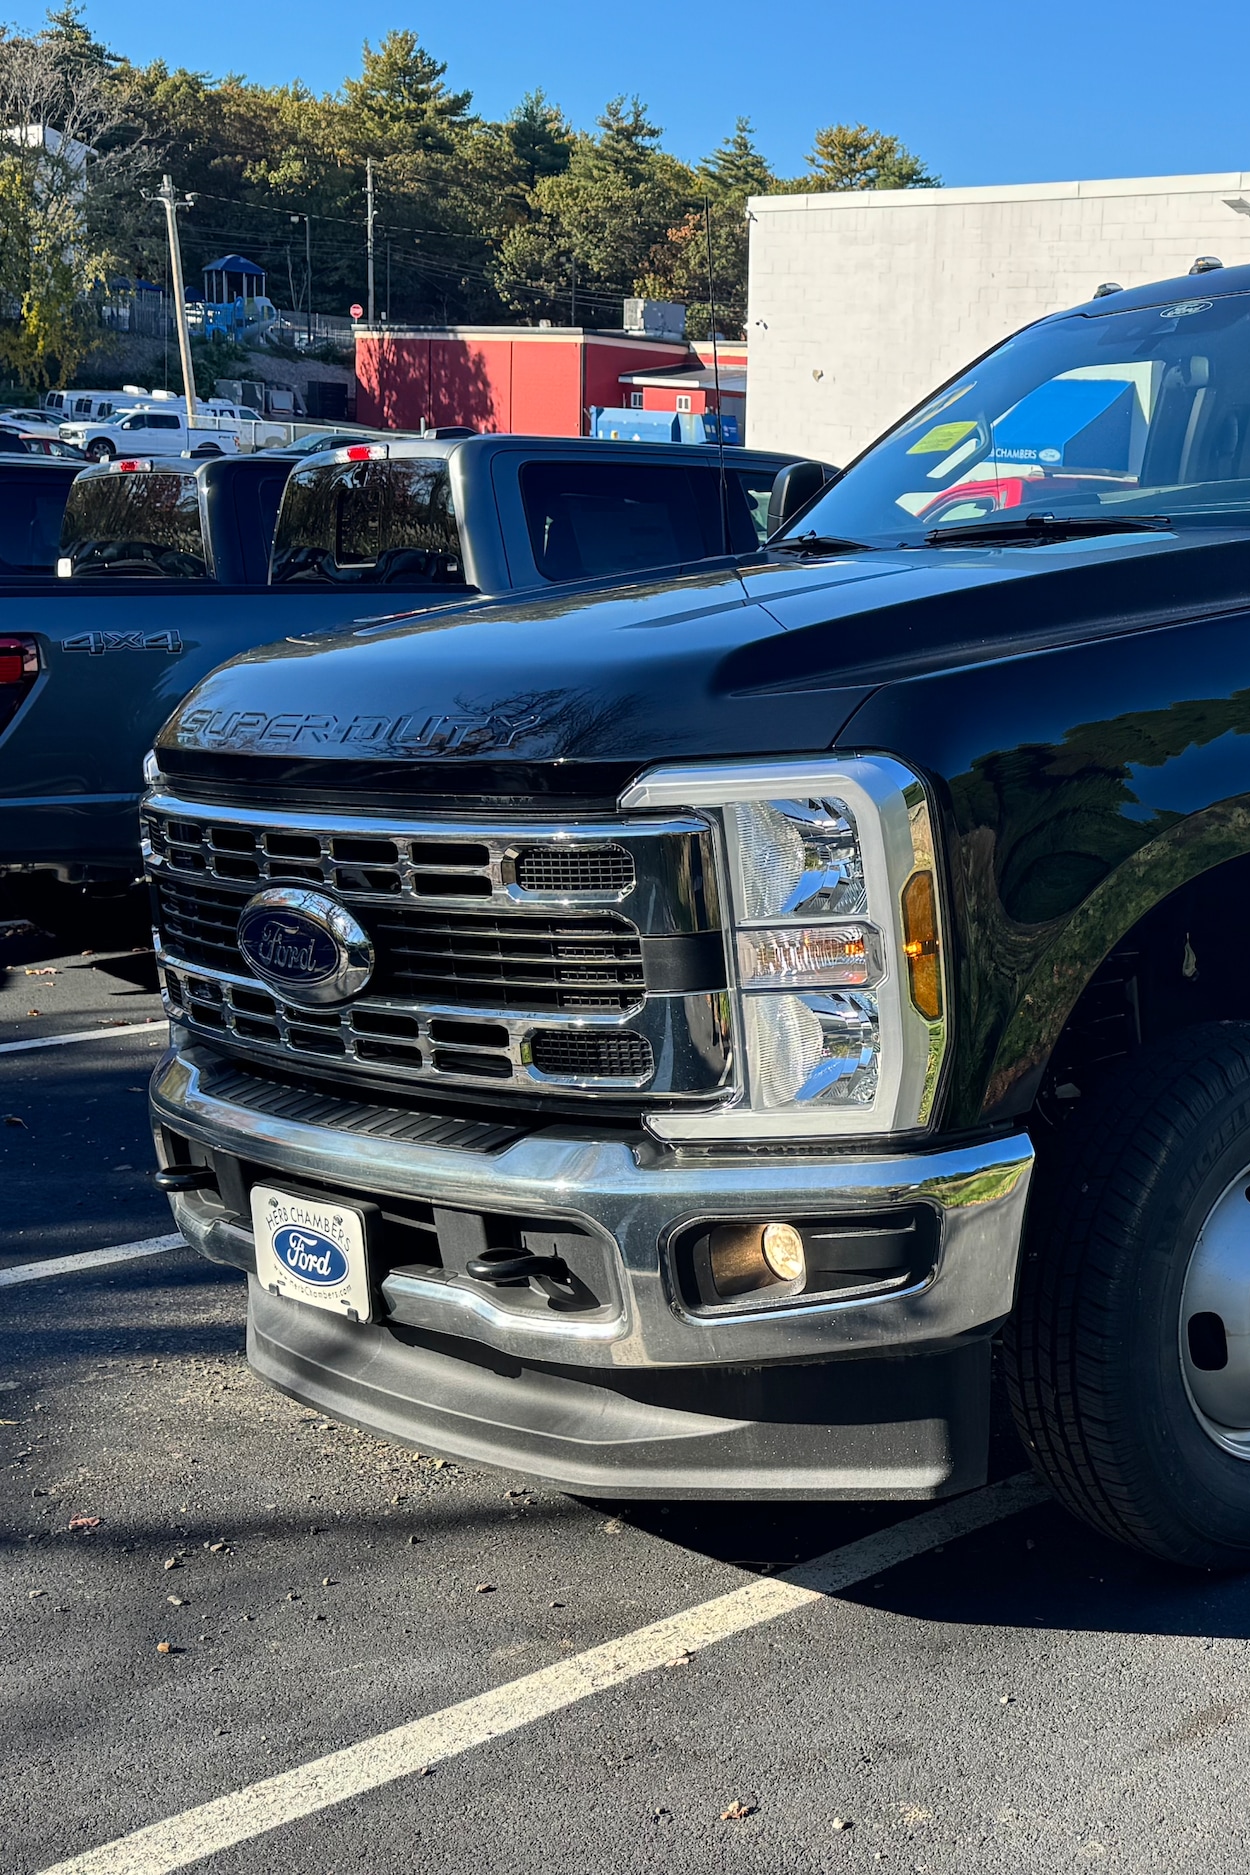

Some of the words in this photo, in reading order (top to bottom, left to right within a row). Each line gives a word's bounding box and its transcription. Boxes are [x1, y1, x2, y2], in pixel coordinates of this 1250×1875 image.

[996, 448, 1037, 460] CHAMBERS
[179, 709, 339, 745] SUPER
[340, 714, 541, 748] DUTY
[259, 920, 316, 971] Ford
[265, 1207, 289, 1230] HERB
[290, 1207, 351, 1252] CHAMBERS
[287, 1232, 332, 1276] Ford
